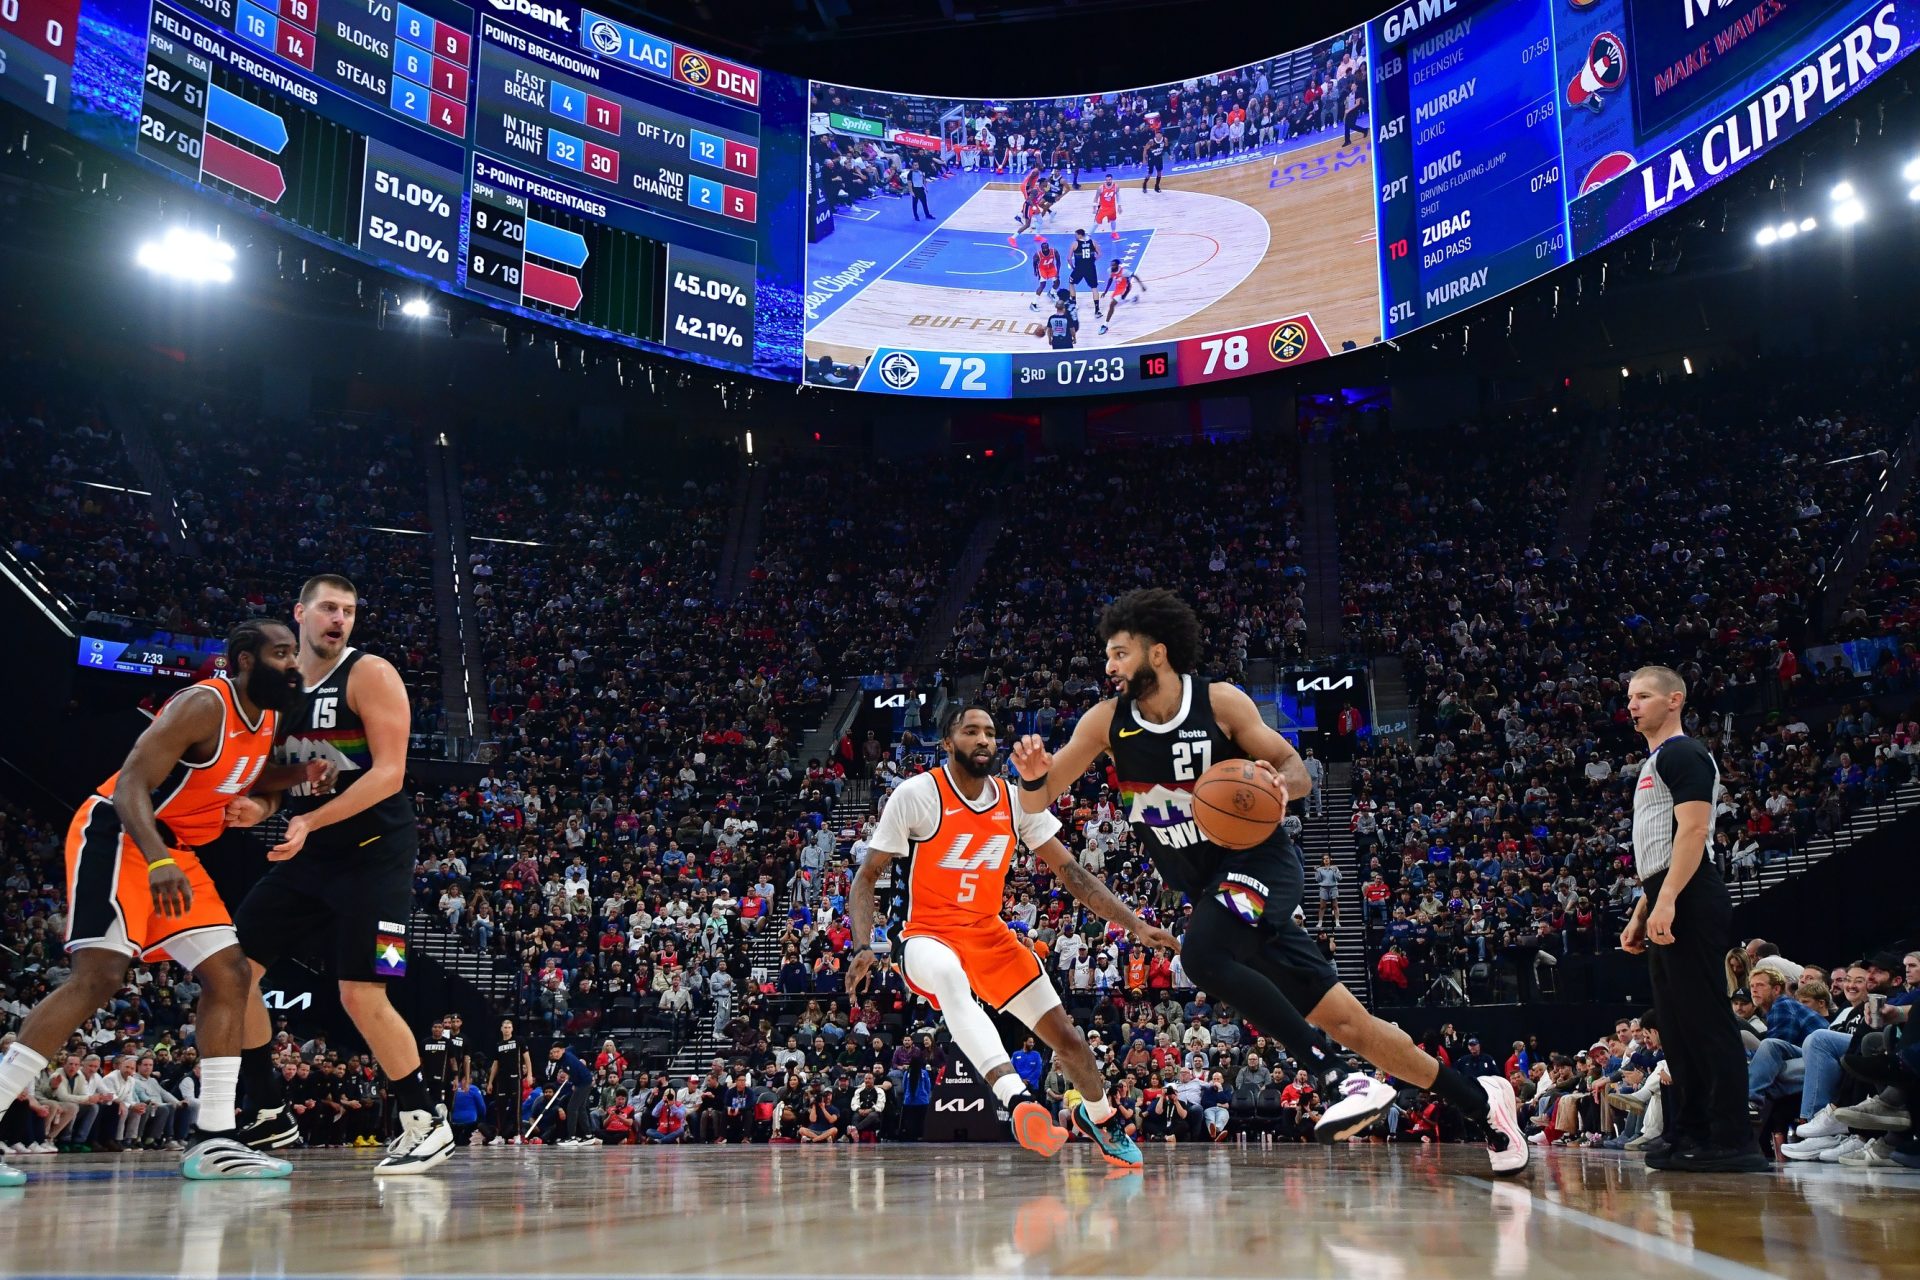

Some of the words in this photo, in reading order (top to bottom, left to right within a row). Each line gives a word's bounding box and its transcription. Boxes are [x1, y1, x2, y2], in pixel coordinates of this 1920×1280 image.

[289, 0, 308, 20] 19
[46, 19, 63, 47] 0
[247, 15, 266, 38] 16
[287, 35, 304, 58] 14
[367, 0, 391, 22] T/O
[410, 20, 420, 37] 8
[446, 37, 457, 54] 9
[1412, 17, 1472, 64] MURRAY
[150, 34, 174, 55] FGM
[187, 53, 207, 73] FGA
[154, 10, 191, 41] FIELD
[193, 32, 228, 62] GOAL
[230, 51, 318, 105] PERCENTAGES
[337, 21, 389, 58] BLOCKS
[407, 56, 418, 73] 6
[446, 73, 454, 89] 1
[485, 24, 526, 51] POINTS
[528, 43, 600, 80] BREAKDOWN
[629, 38, 667, 70] LAC
[1522, 37, 1549, 64] 07:59
[515, 69, 546, 92] FAST
[1376, 57, 1402, 84] REB
[1413, 47, 1464, 86] DEFENSIVE
[1653, 41, 1712, 96] MAKE
[44, 73, 57, 104] 1
[336, 60, 386, 95] STEALS
[404, 92, 416, 110] 2
[442, 108, 453, 126] 4
[717, 69, 755, 98] DEN
[504, 80, 545, 108] BREAK
[562, 95, 573, 112] 4
[597, 108, 610, 125] 11
[1415, 77, 1477, 124] MURRAY
[1526, 101, 1554, 128] 07:59
[1641, 148, 1695, 213] LA
[1701, 2, 1901, 175] CLIPPERS
[503, 113, 518, 131] IN
[519, 119, 543, 141] THE
[841, 117, 872, 132] Sprite
[1378, 115, 1406, 144] AST
[1417, 121, 1446, 146] JOKIC
[505, 130, 543, 155] PAINT
[556, 142, 575, 162] 32
[591, 154, 611, 173] 30
[638, 122, 660, 140] OFF
[663, 129, 685, 148] T/O
[699, 142, 715, 159] 12
[735, 152, 747, 168] 11
[659, 168, 684, 187] 2ND
[1419, 150, 1462, 185] JOKIC
[1420, 181, 1449, 202] DRIVING
[1450, 163, 1484, 187] FLOATING
[1485, 152, 1507, 172] JUMP
[1530, 166, 1559, 193] 07:40
[374, 170, 451, 218] 51.0%
[473, 183, 494, 199] 3PM
[505, 195, 524, 209] 3PA
[476, 162, 525, 190] 3-POINT
[526, 181, 606, 217] PERCENTAGES
[633, 174, 683, 202] CHANCE
[701, 188, 711, 204] 2
[734, 197, 744, 213] 5
[1382, 175, 1408, 203] 2PT
[475, 211, 487, 230] 9
[1420, 200, 1441, 218] SHOT
[368, 215, 450, 264] 52.0%
[1422, 210, 1471, 247] ZUBAC
[1081, 248, 1091, 259] 15
[1389, 239, 1408, 261] TO
[1423, 248, 1444, 269] BAD
[1446, 236, 1472, 259] PASS
[1535, 233, 1564, 259] 07:40
[473, 255, 485, 274] 8
[674, 271, 747, 307] 45.0%
[1426, 266, 1489, 309] MURRAY
[908, 314, 1042, 336] BUFFALO
[1389, 300, 1415, 324] STL
[675, 314, 743, 348] 42.1%
[1146, 357, 1165, 375] 16
[1200, 334, 1250, 376] 78
[939, 356, 987, 391] 72
[1020, 366, 1046, 383] 3RD
[1057, 357, 1125, 385] 07:33
[89, 652, 103, 665] 72
[142, 652, 163, 664] 7:33
[312, 697, 339, 729] 15
[1178, 729, 1207, 739] ibotta
[1172, 739, 1212, 781] 27
[937, 833, 1011, 871] LA
[957, 872, 980, 903] 5
[1226, 871, 1270, 897] NUGGETS
[378, 920, 406, 935] NUGGETS
[424, 1043, 446, 1051] DENVER
[498, 1042, 517, 1052] DENVER
